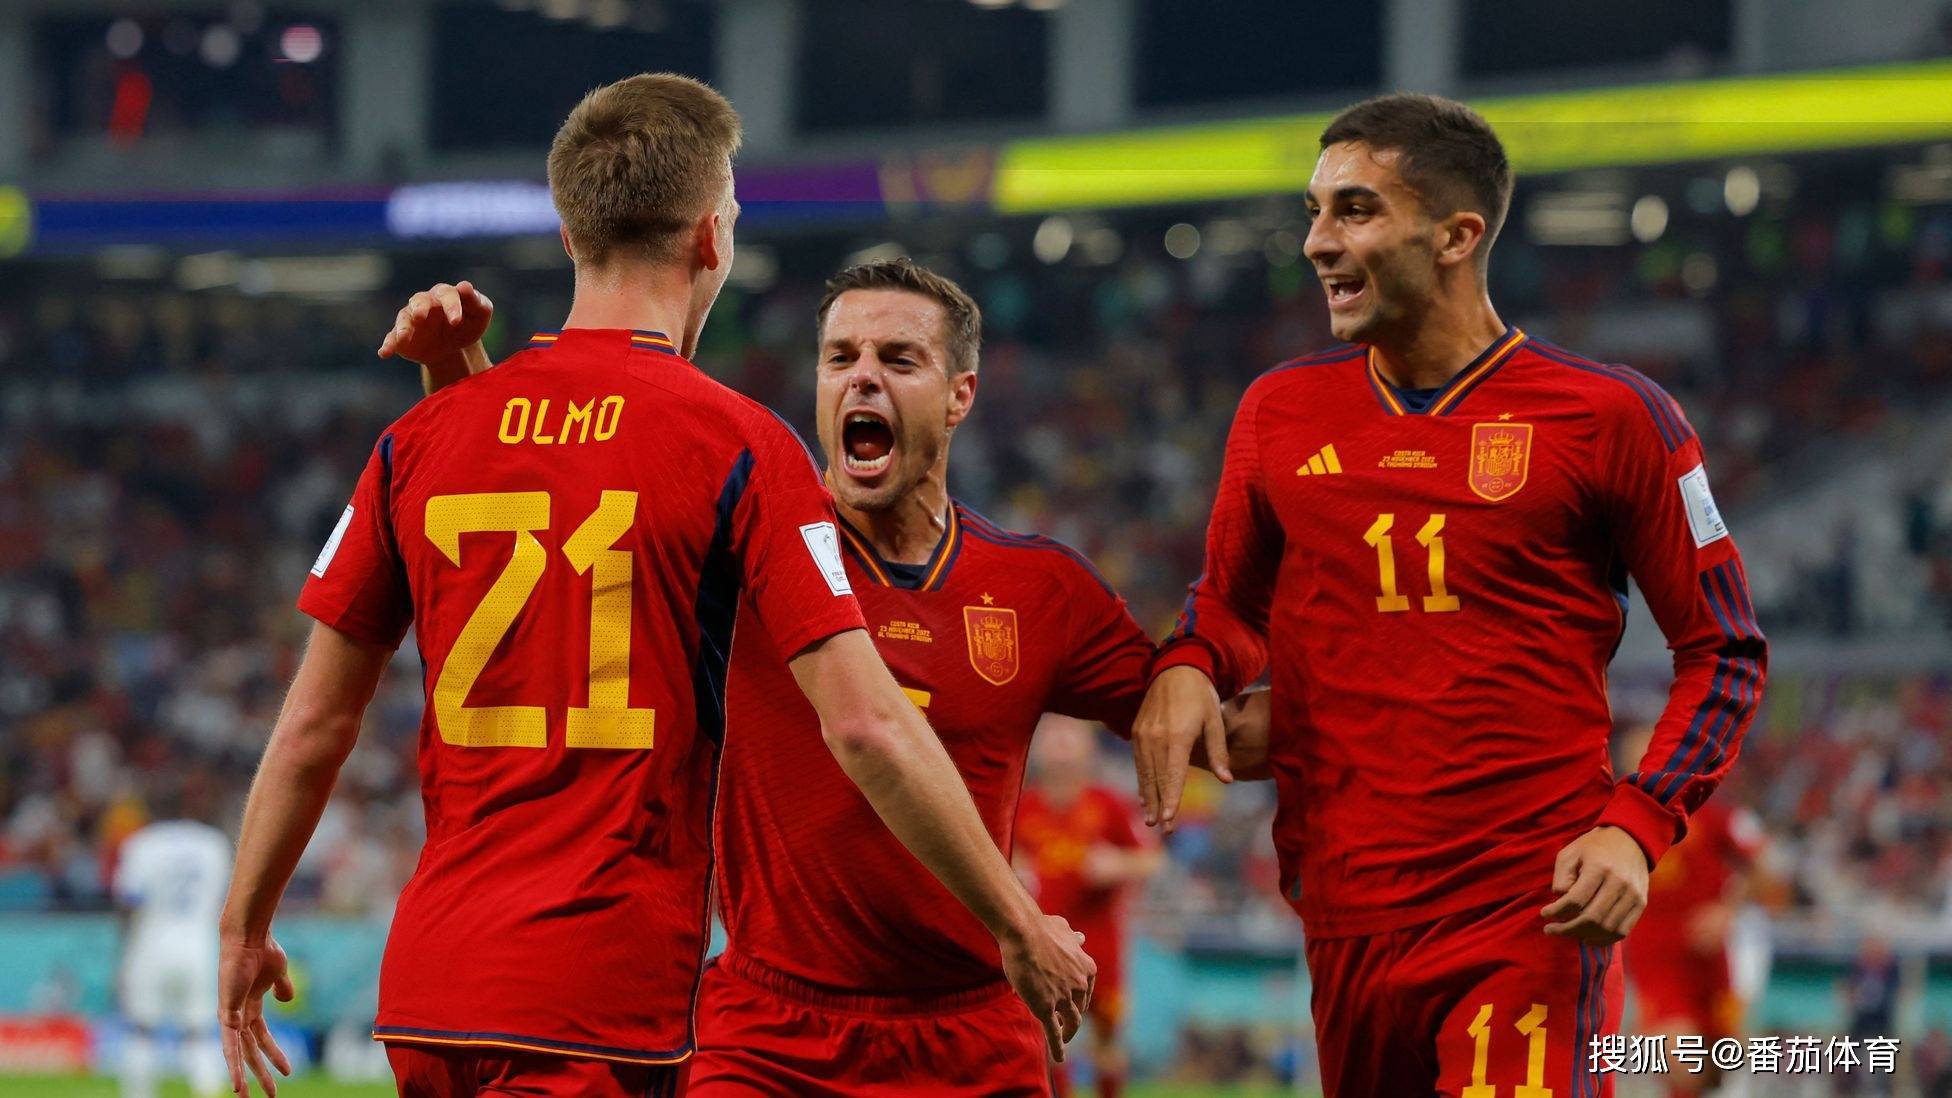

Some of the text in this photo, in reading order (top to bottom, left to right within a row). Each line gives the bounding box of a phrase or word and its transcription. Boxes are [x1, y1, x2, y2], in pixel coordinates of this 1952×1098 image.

[498, 395, 625, 445] OLMO
[1363, 513, 1460, 612] 11
[425, 490, 655, 749] 21
[1462, 1003, 1553, 1098] 11
